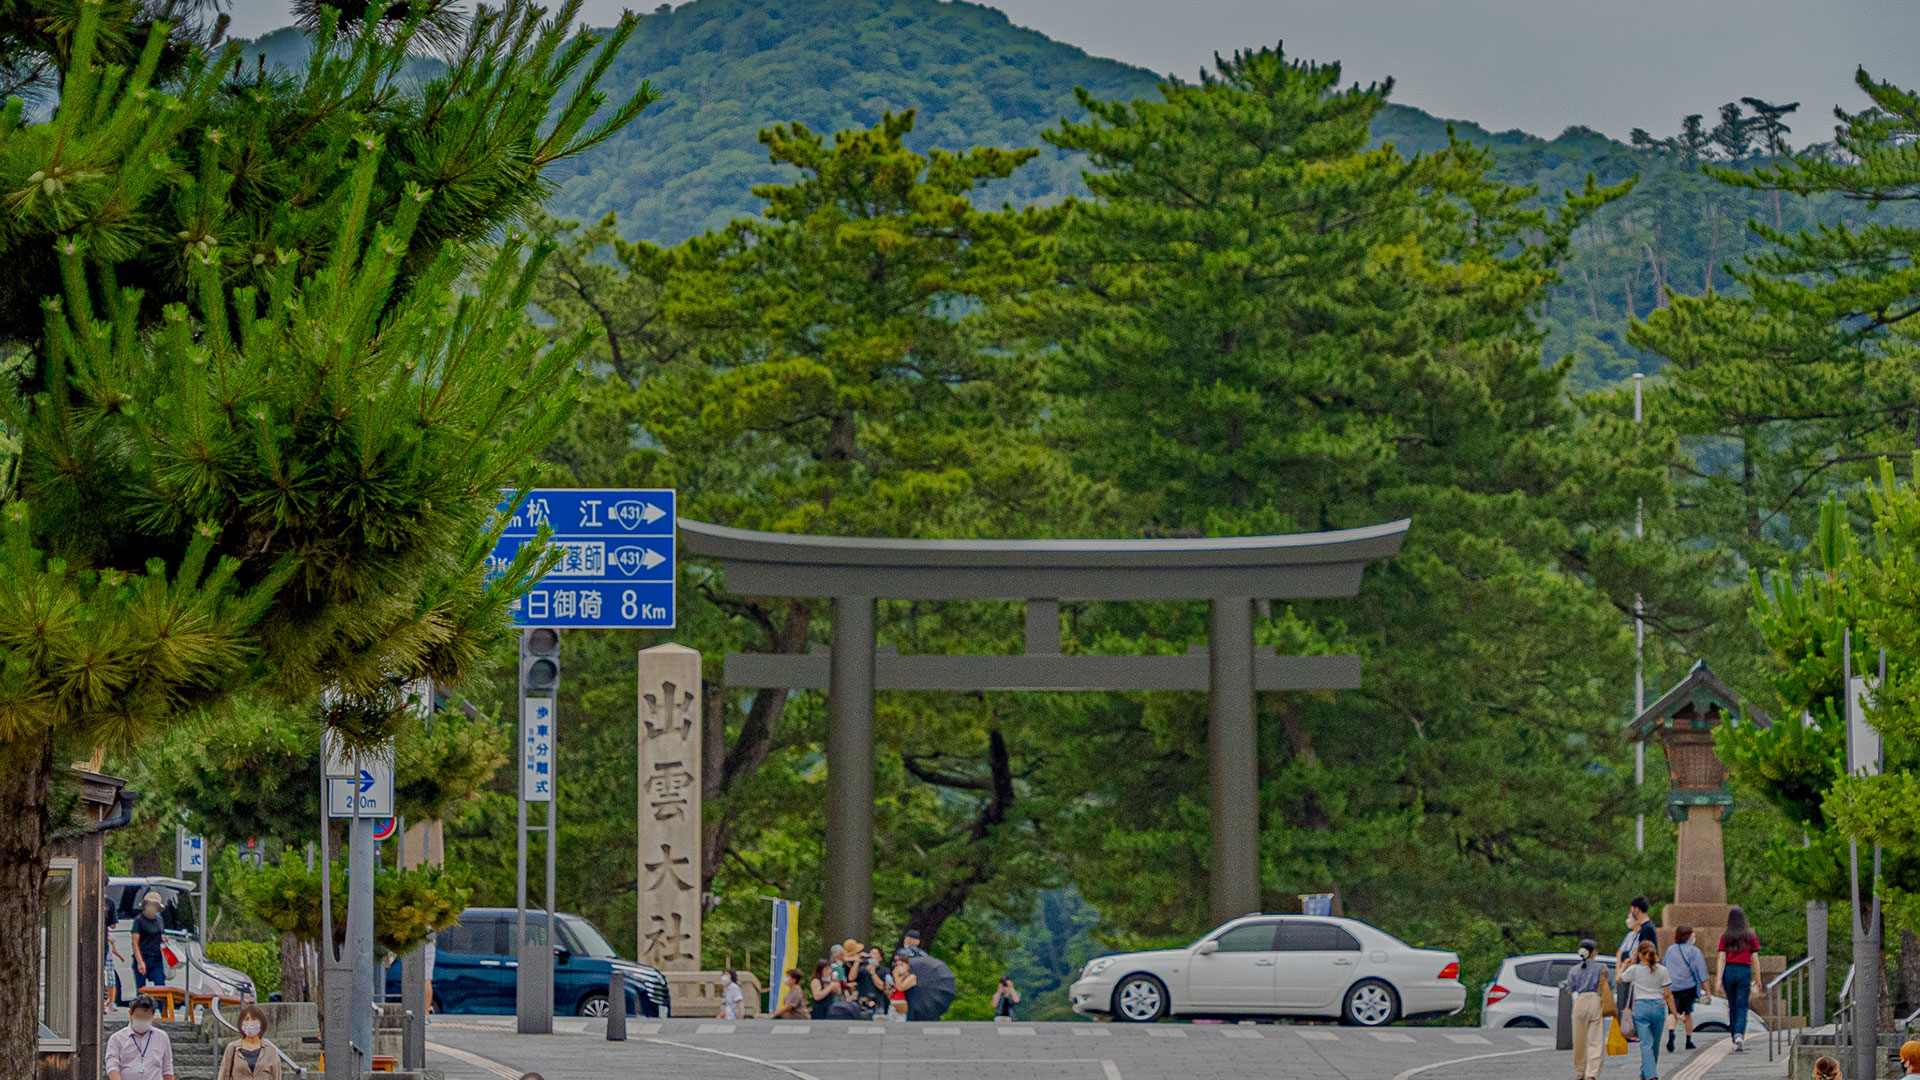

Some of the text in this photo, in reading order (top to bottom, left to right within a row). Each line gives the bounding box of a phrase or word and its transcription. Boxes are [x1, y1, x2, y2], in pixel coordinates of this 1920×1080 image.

[527, 499, 603, 528] 松江
[620, 506, 640, 520] 431
[620, 551, 640, 565] 431
[346, 795, 377, 809] 20m
[643, 681, 694, 968] 出雲大社
